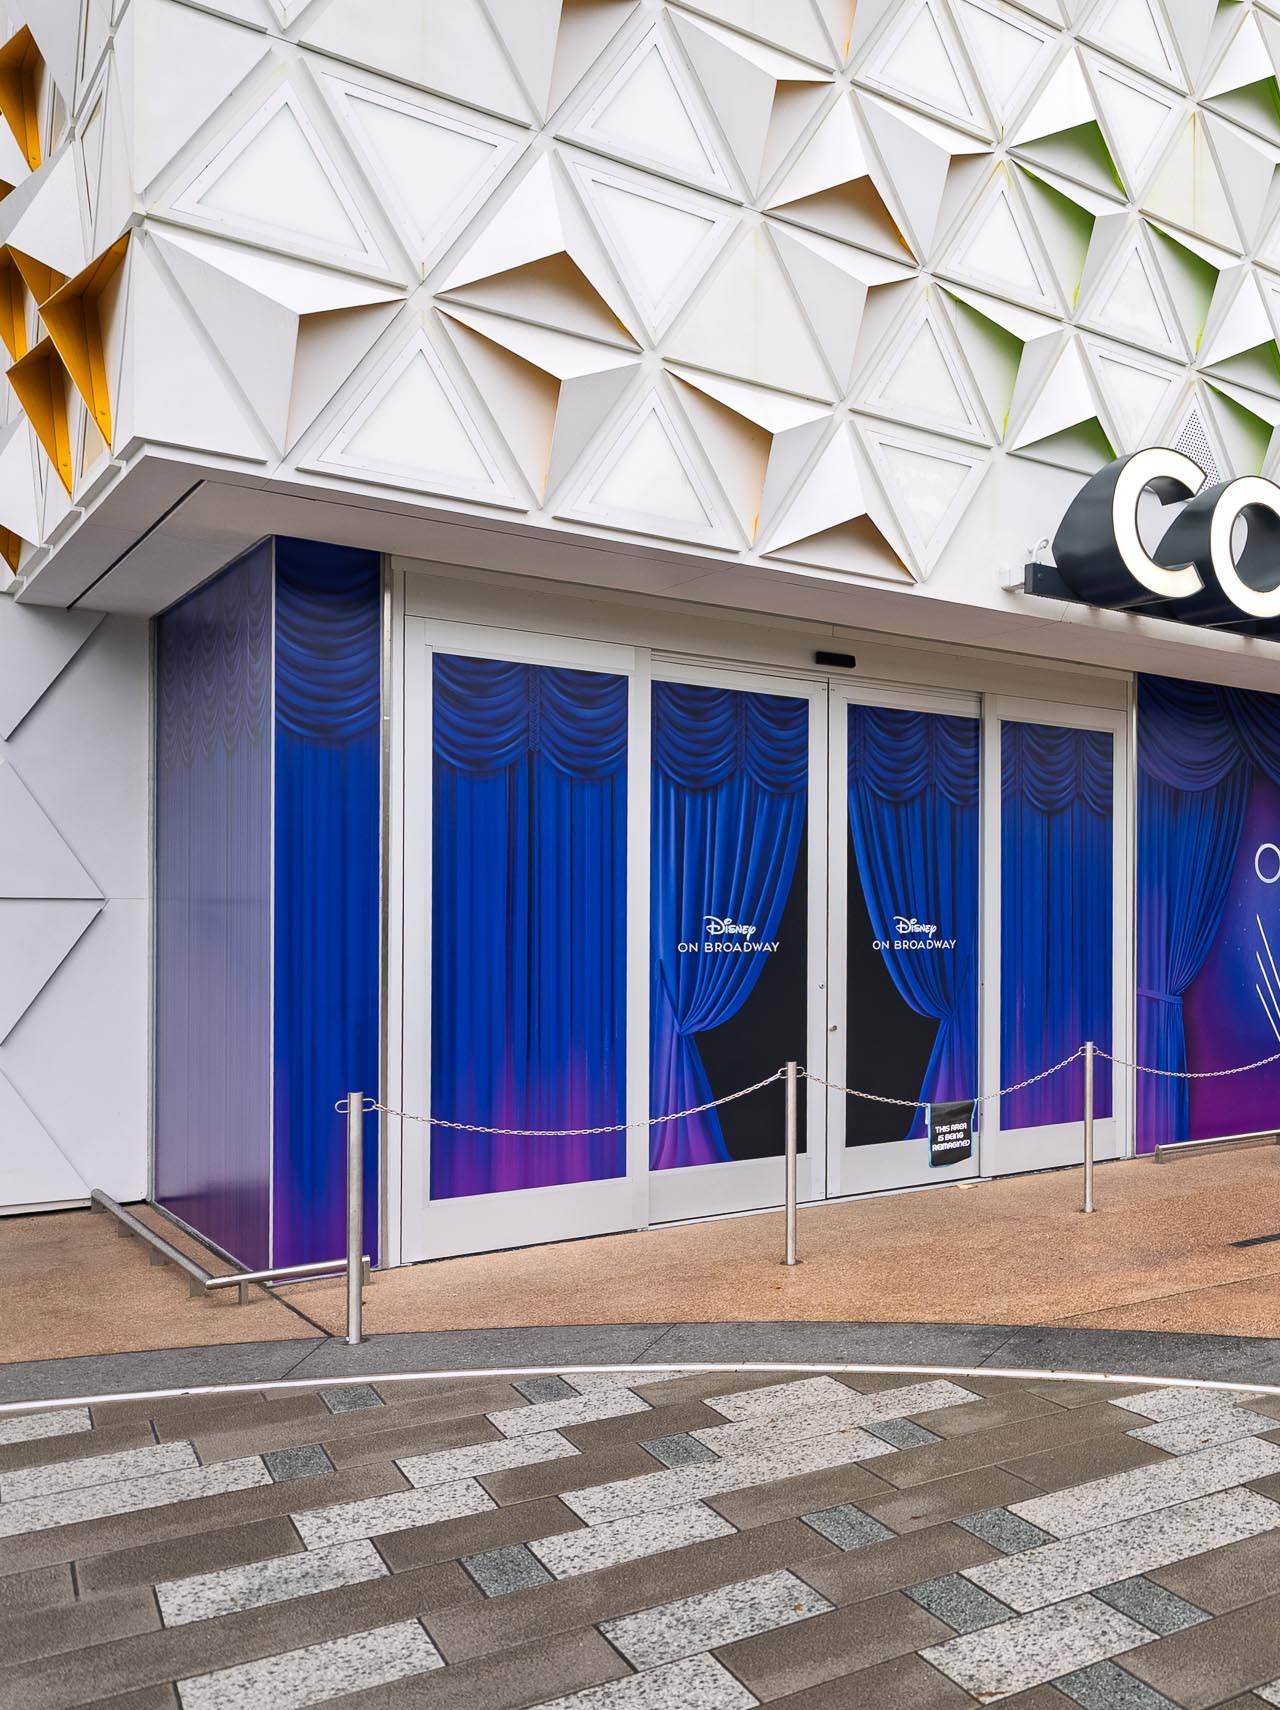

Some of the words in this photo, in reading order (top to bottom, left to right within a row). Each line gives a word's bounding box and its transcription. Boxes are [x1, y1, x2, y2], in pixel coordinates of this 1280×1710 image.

[703, 915, 756, 941] Disney
[893, 915, 937, 939] Disney
[677, 942, 699, 953] ON
[704, 941, 780, 953] BROADWAY
[872, 940, 890, 950] ON
[894, 939, 957, 950] BROADWAY
[935, 1125, 950, 1133] THIS
[951, 1122, 967, 1131] AREA
[945, 1132, 964, 1140] BEING
[932, 1139, 970, 1151] REIMAGINED
